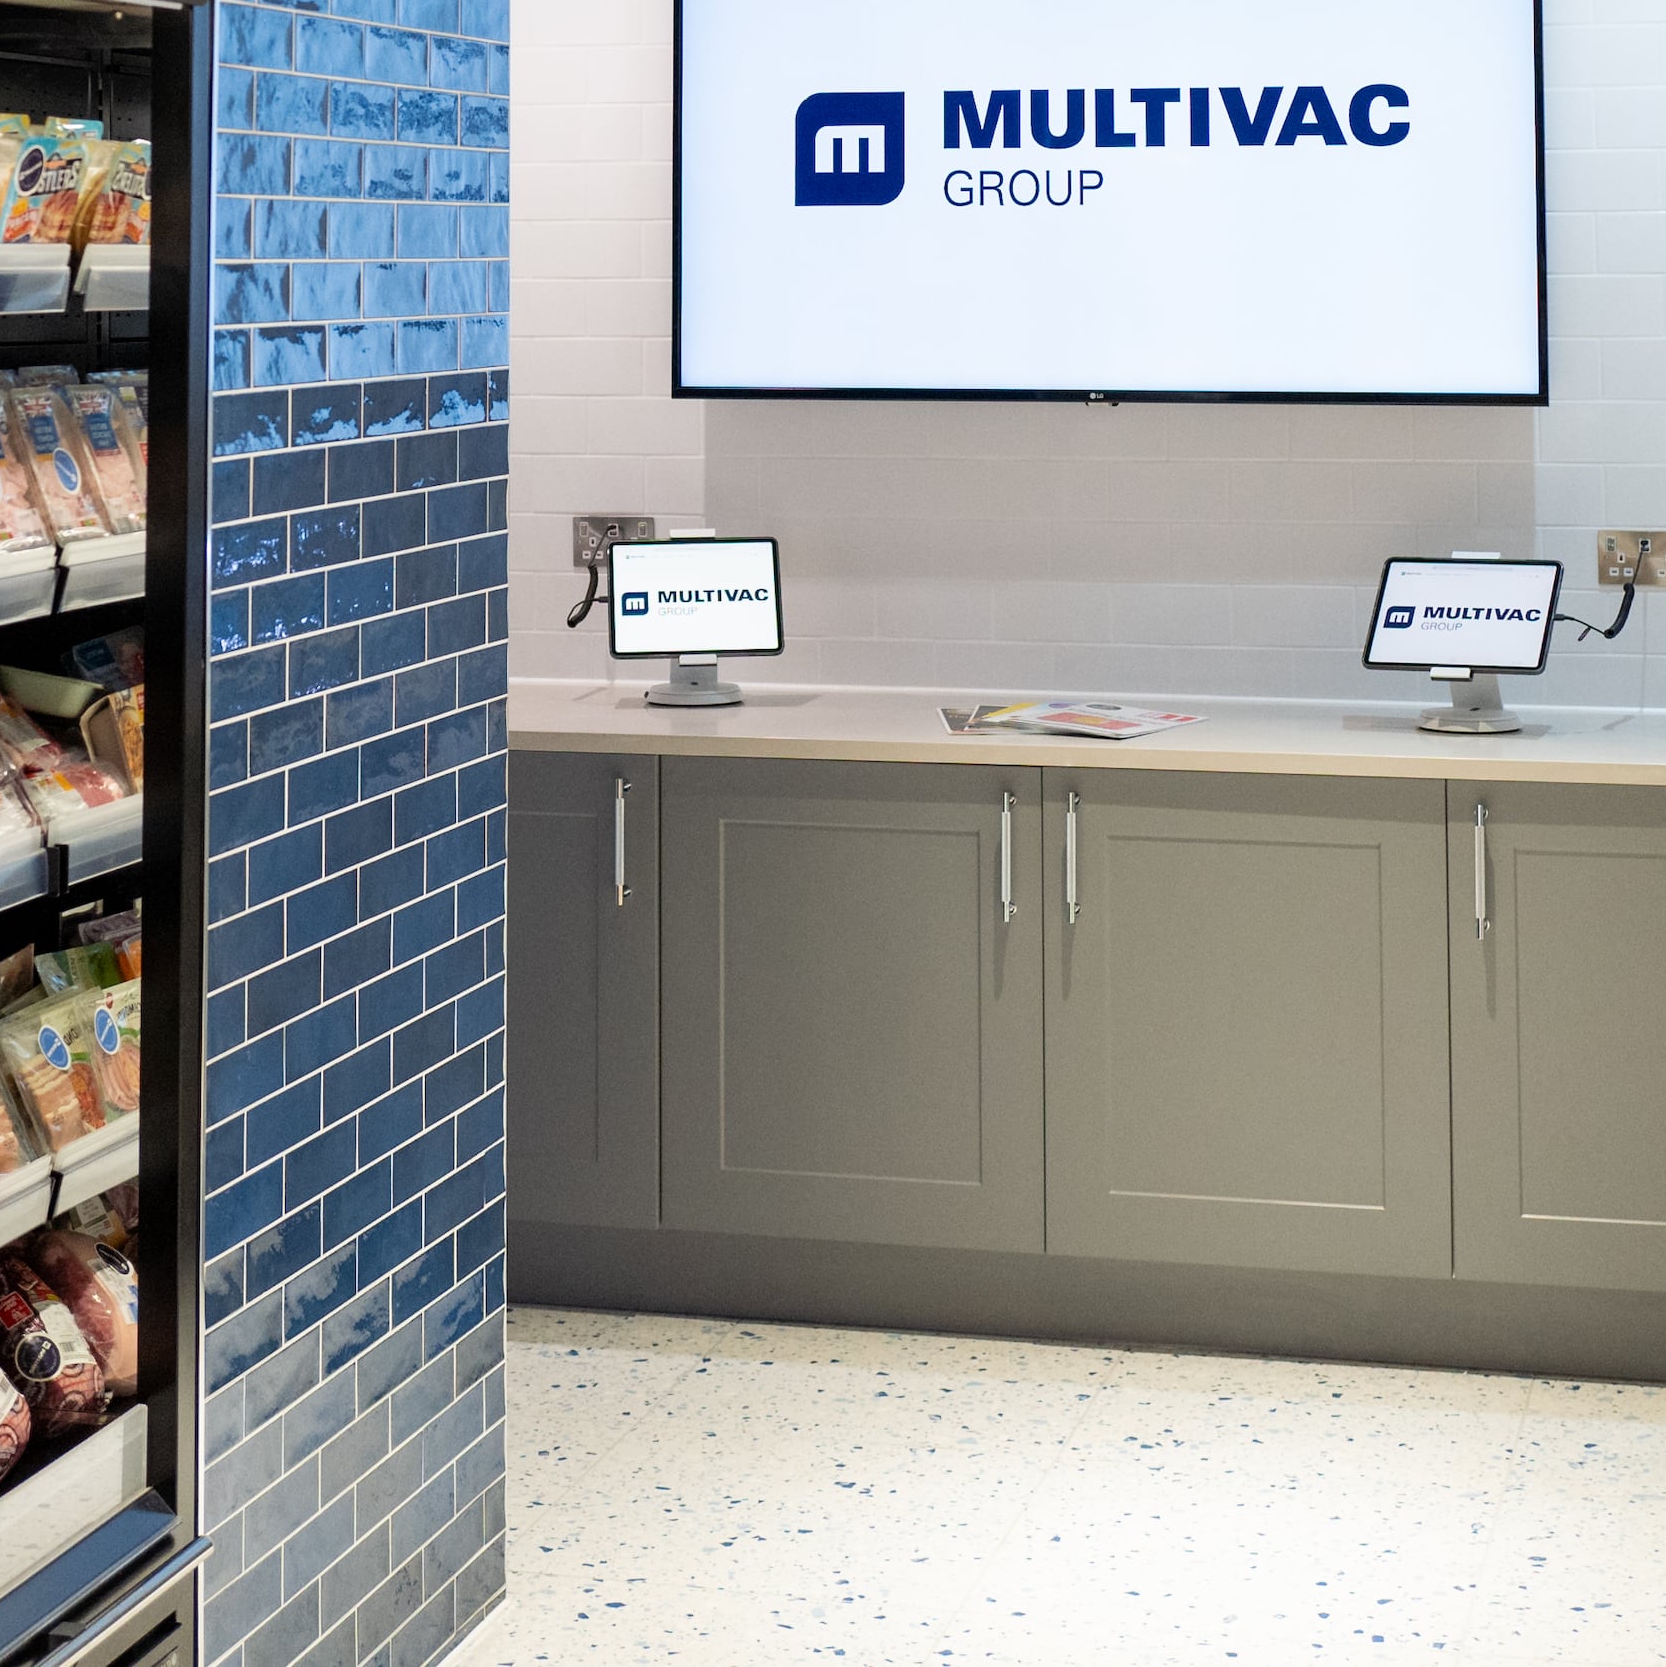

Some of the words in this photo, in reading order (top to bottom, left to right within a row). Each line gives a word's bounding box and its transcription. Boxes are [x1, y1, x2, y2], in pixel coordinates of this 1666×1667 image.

[943, 84, 1410, 149] MULTIVAC
[36, 160, 81, 194] STLERS
[943, 169, 1104, 206] GROUP
[658, 588, 769, 604] MULTIVAC
[658, 606, 698, 617] GROUP
[1423, 606, 1541, 622] MULTIVAC
[1421, 622, 1463, 631] GROUP
